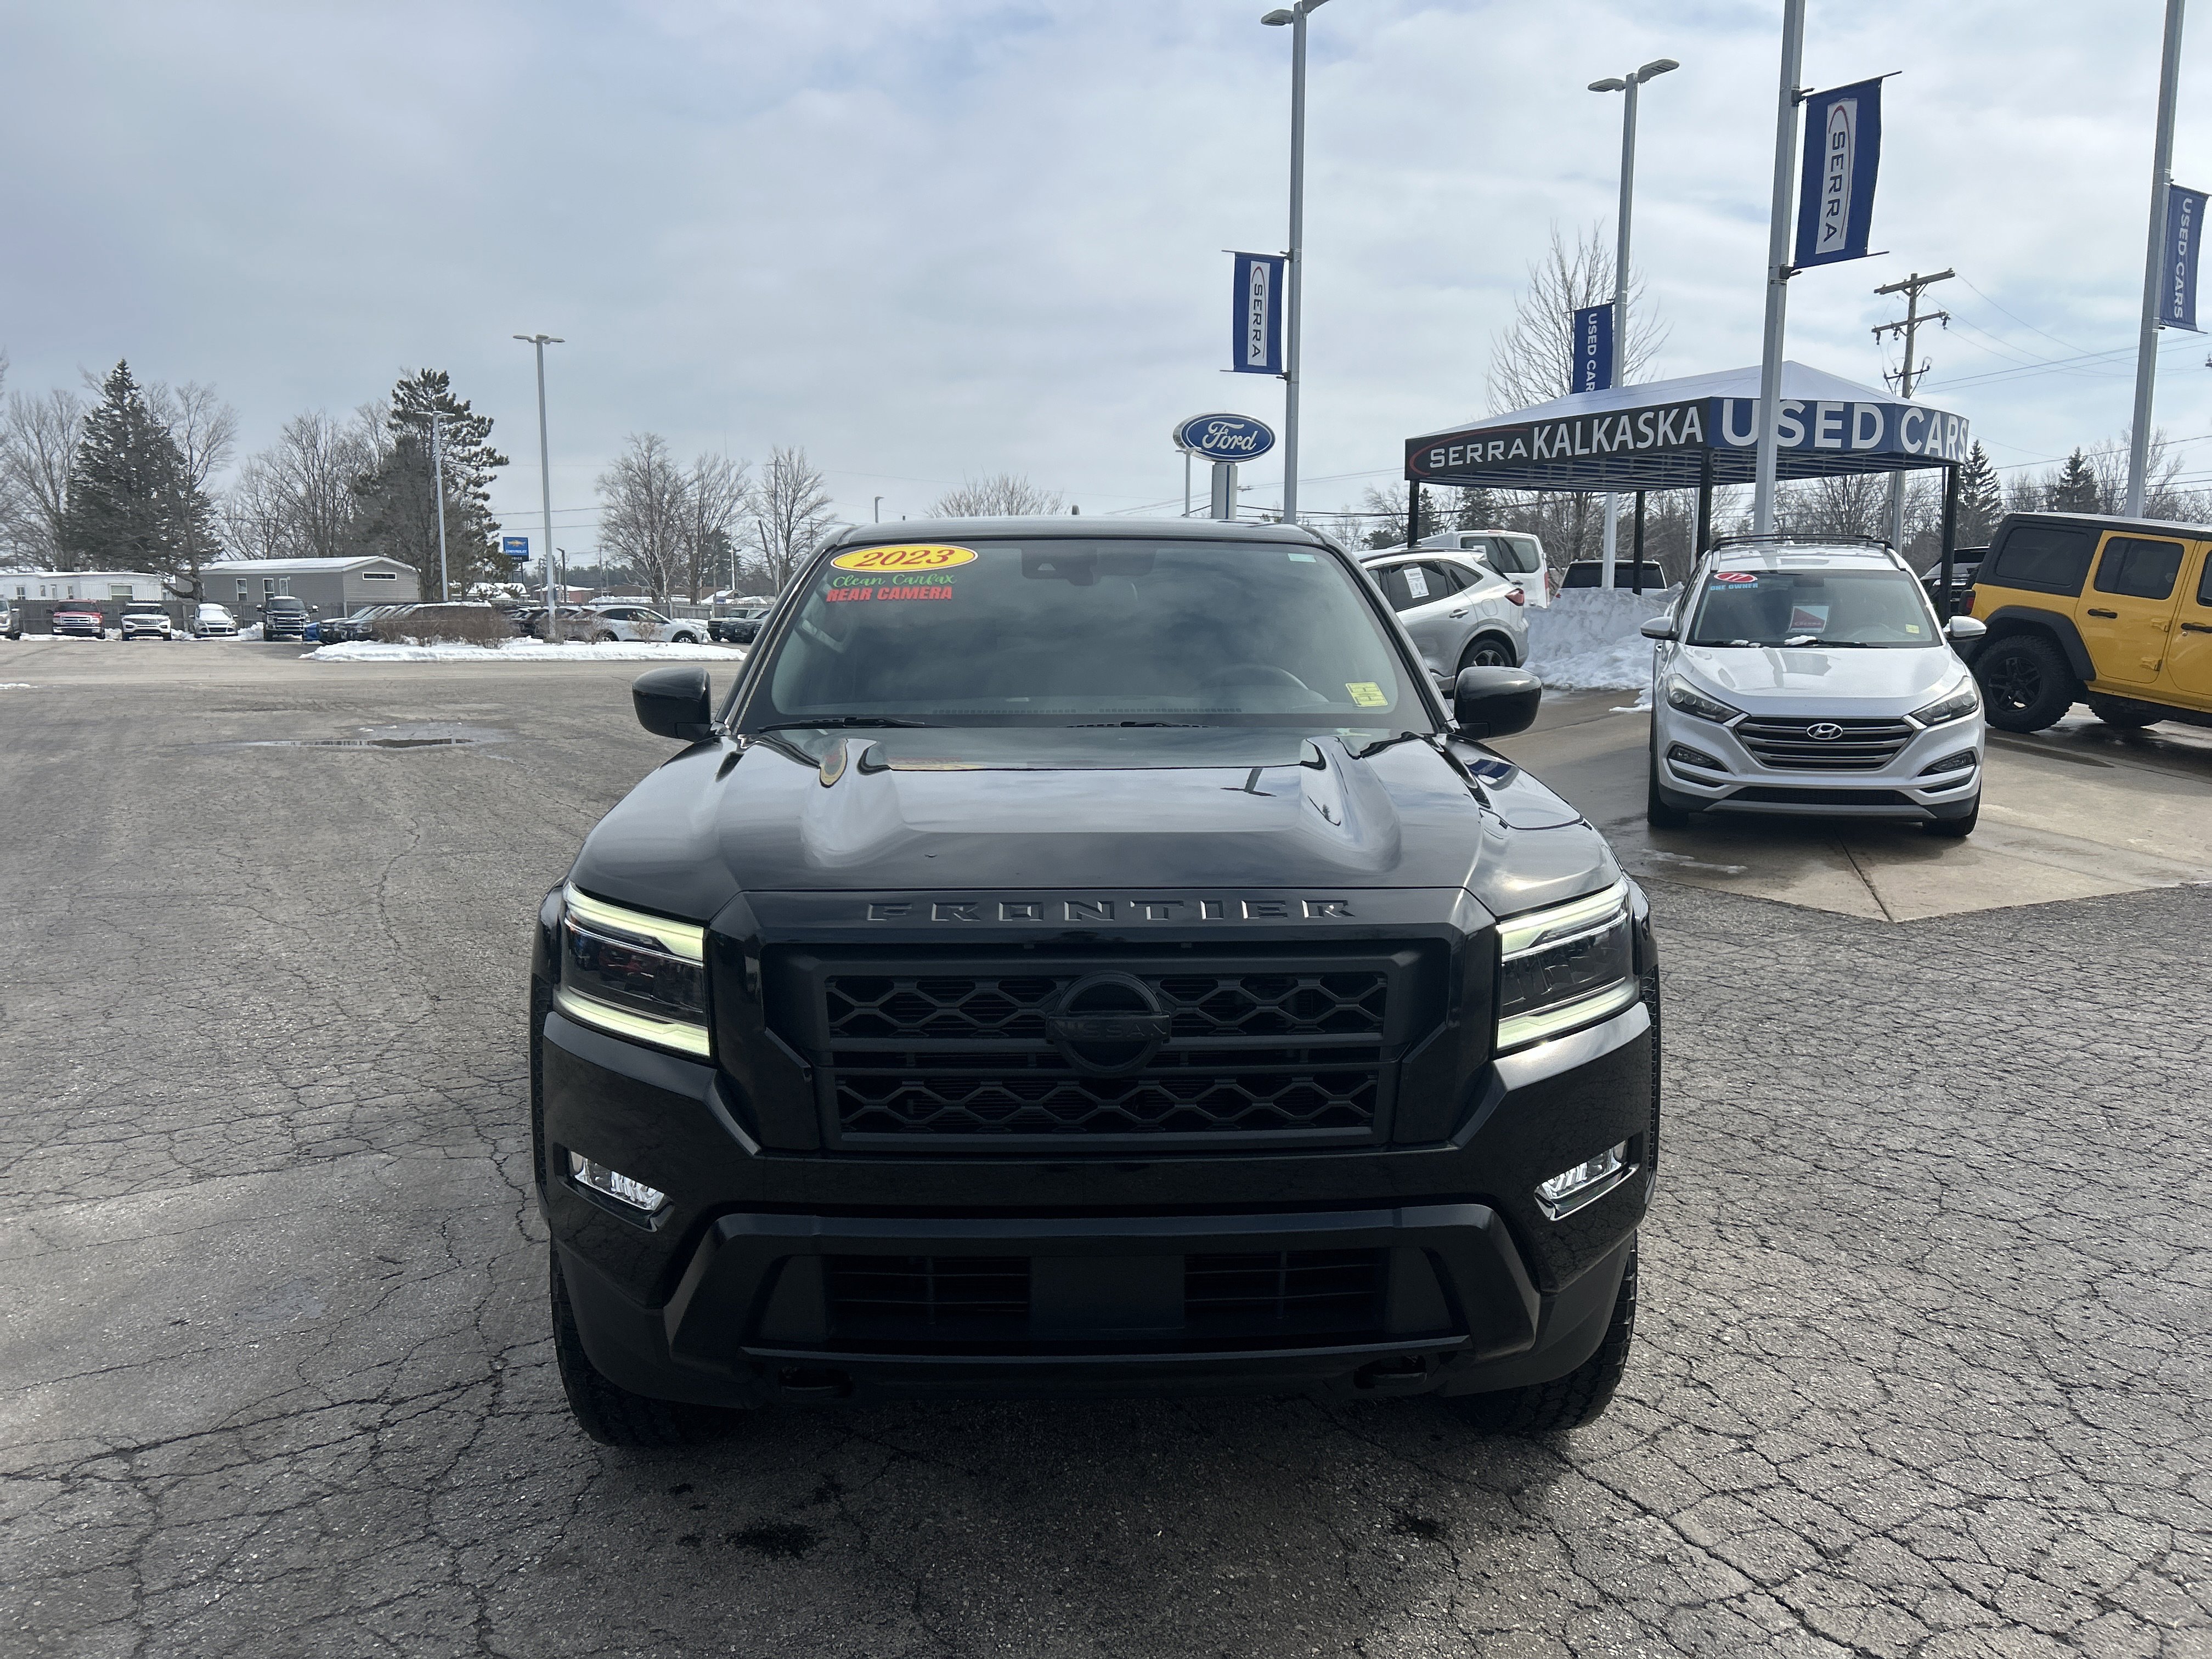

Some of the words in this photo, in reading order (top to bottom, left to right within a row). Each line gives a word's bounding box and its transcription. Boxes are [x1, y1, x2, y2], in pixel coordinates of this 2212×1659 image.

[1823, 131, 1846, 242] SERRA
[2178, 198, 2192, 256] USED
[2174, 262, 2185, 319] CARS
[1252, 283, 1263, 358] SERRA
[1588, 313, 1597, 356] USED
[1585, 359, 1596, 392] CAR
[1202, 421, 1259, 450] Ford
[1429, 438, 1528, 469] SERRA
[1533, 406, 1703, 460] KALKASKA
[1722, 399, 1885, 449] USED
[1900, 407, 1968, 465] CARS
[854, 549, 955, 567] 2023
[826, 588, 873, 602] REAR
[877, 586, 953, 600] CAMERA
[833, 575, 885, 588] Clean
[892, 574, 957, 585] Carfax
[866, 899, 1356, 922] FRONTIER
